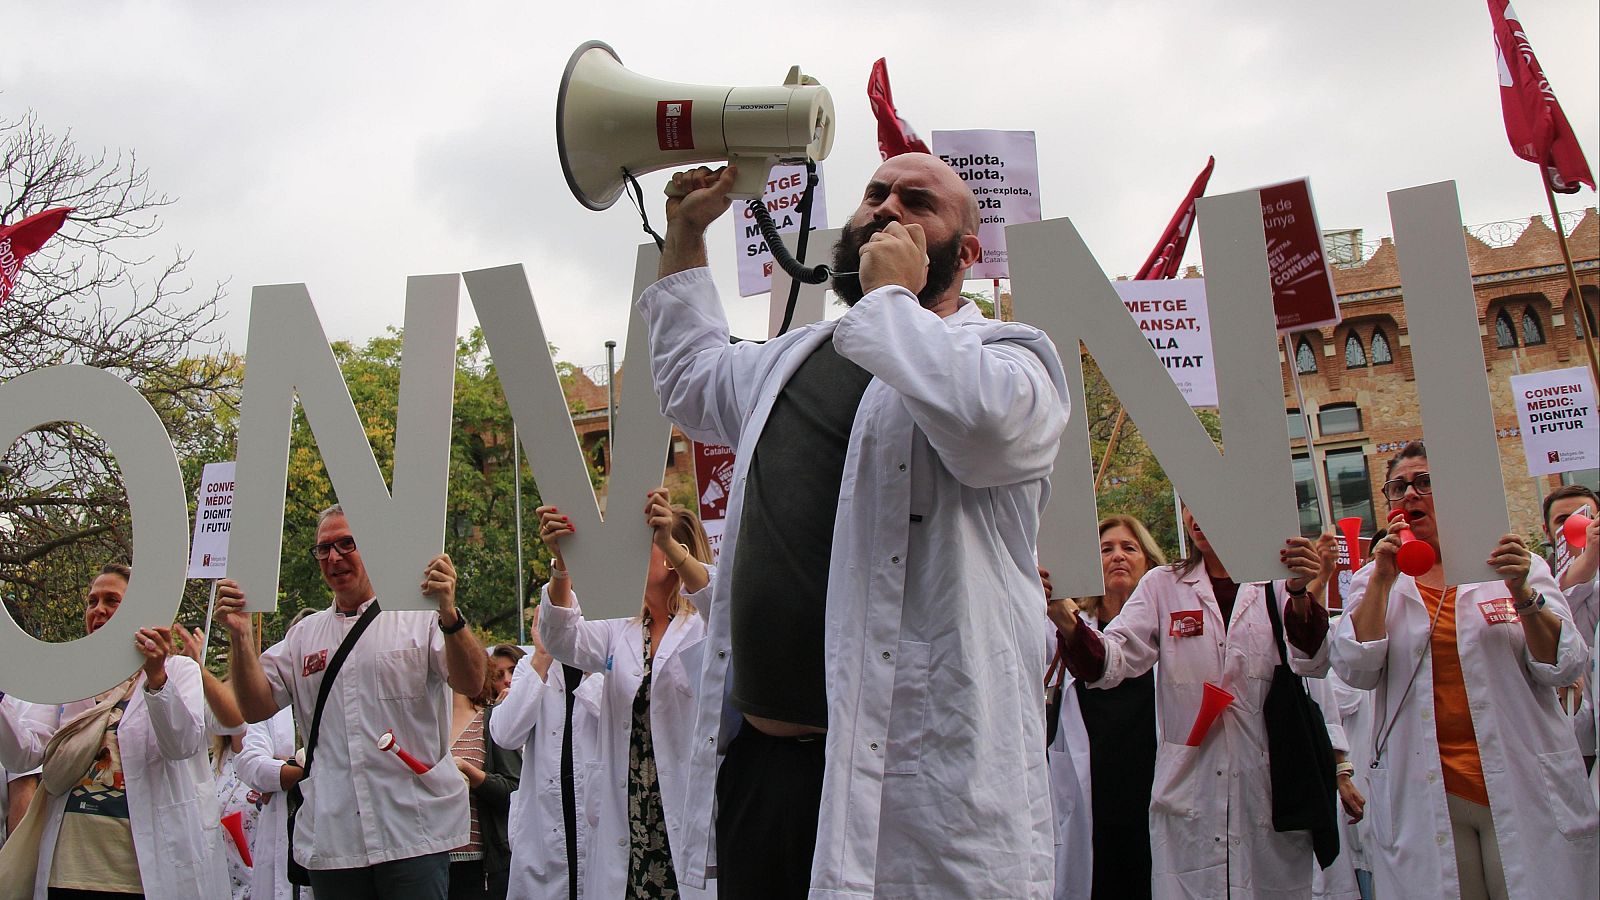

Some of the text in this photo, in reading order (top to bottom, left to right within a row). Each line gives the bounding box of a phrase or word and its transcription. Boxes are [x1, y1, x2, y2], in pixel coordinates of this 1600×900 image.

[939, 153, 1005, 168] Explota,
[955, 168, 1005, 182] plota,
[764, 173, 801, 194] TGE
[1275, 198, 1292, 212] de
[1274, 250, 1320, 286] CONVENI
[1124, 299, 1187, 313] METGE
[1525, 384, 1582, 399] CONVENI
[1527, 397, 1574, 411] MÈDIC:
[1529, 407, 1588, 423] DIGNITAT
[1532, 420, 1584, 434] I FUTUR
[203, 508, 232, 520] DIGNIT
